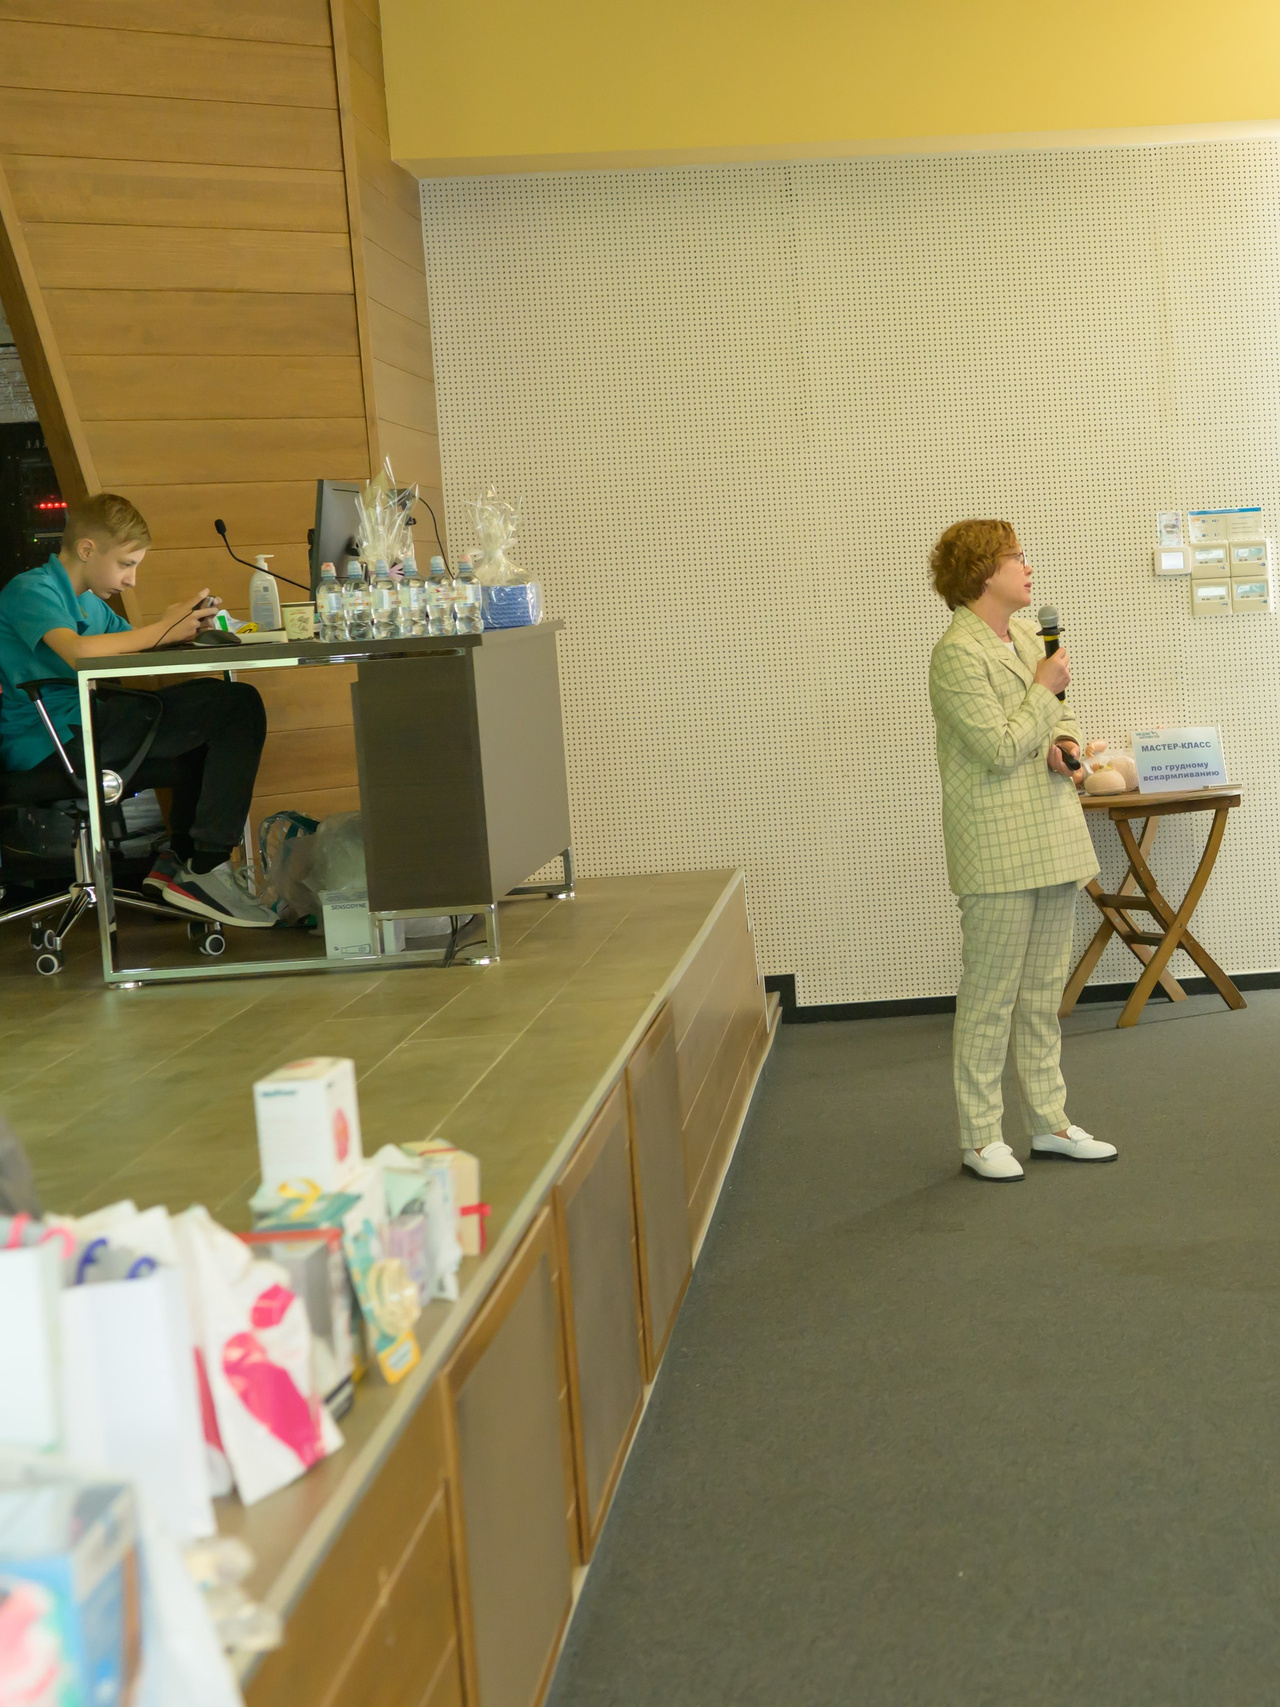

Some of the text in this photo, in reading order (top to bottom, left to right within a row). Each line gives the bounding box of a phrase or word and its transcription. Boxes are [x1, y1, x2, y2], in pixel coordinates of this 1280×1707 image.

[1141, 741, 1212, 752] МАСТЕР-КЛАСС
[1165, 762, 1209, 772] грудному
[1143, 770, 1220, 781] вскармливанию
